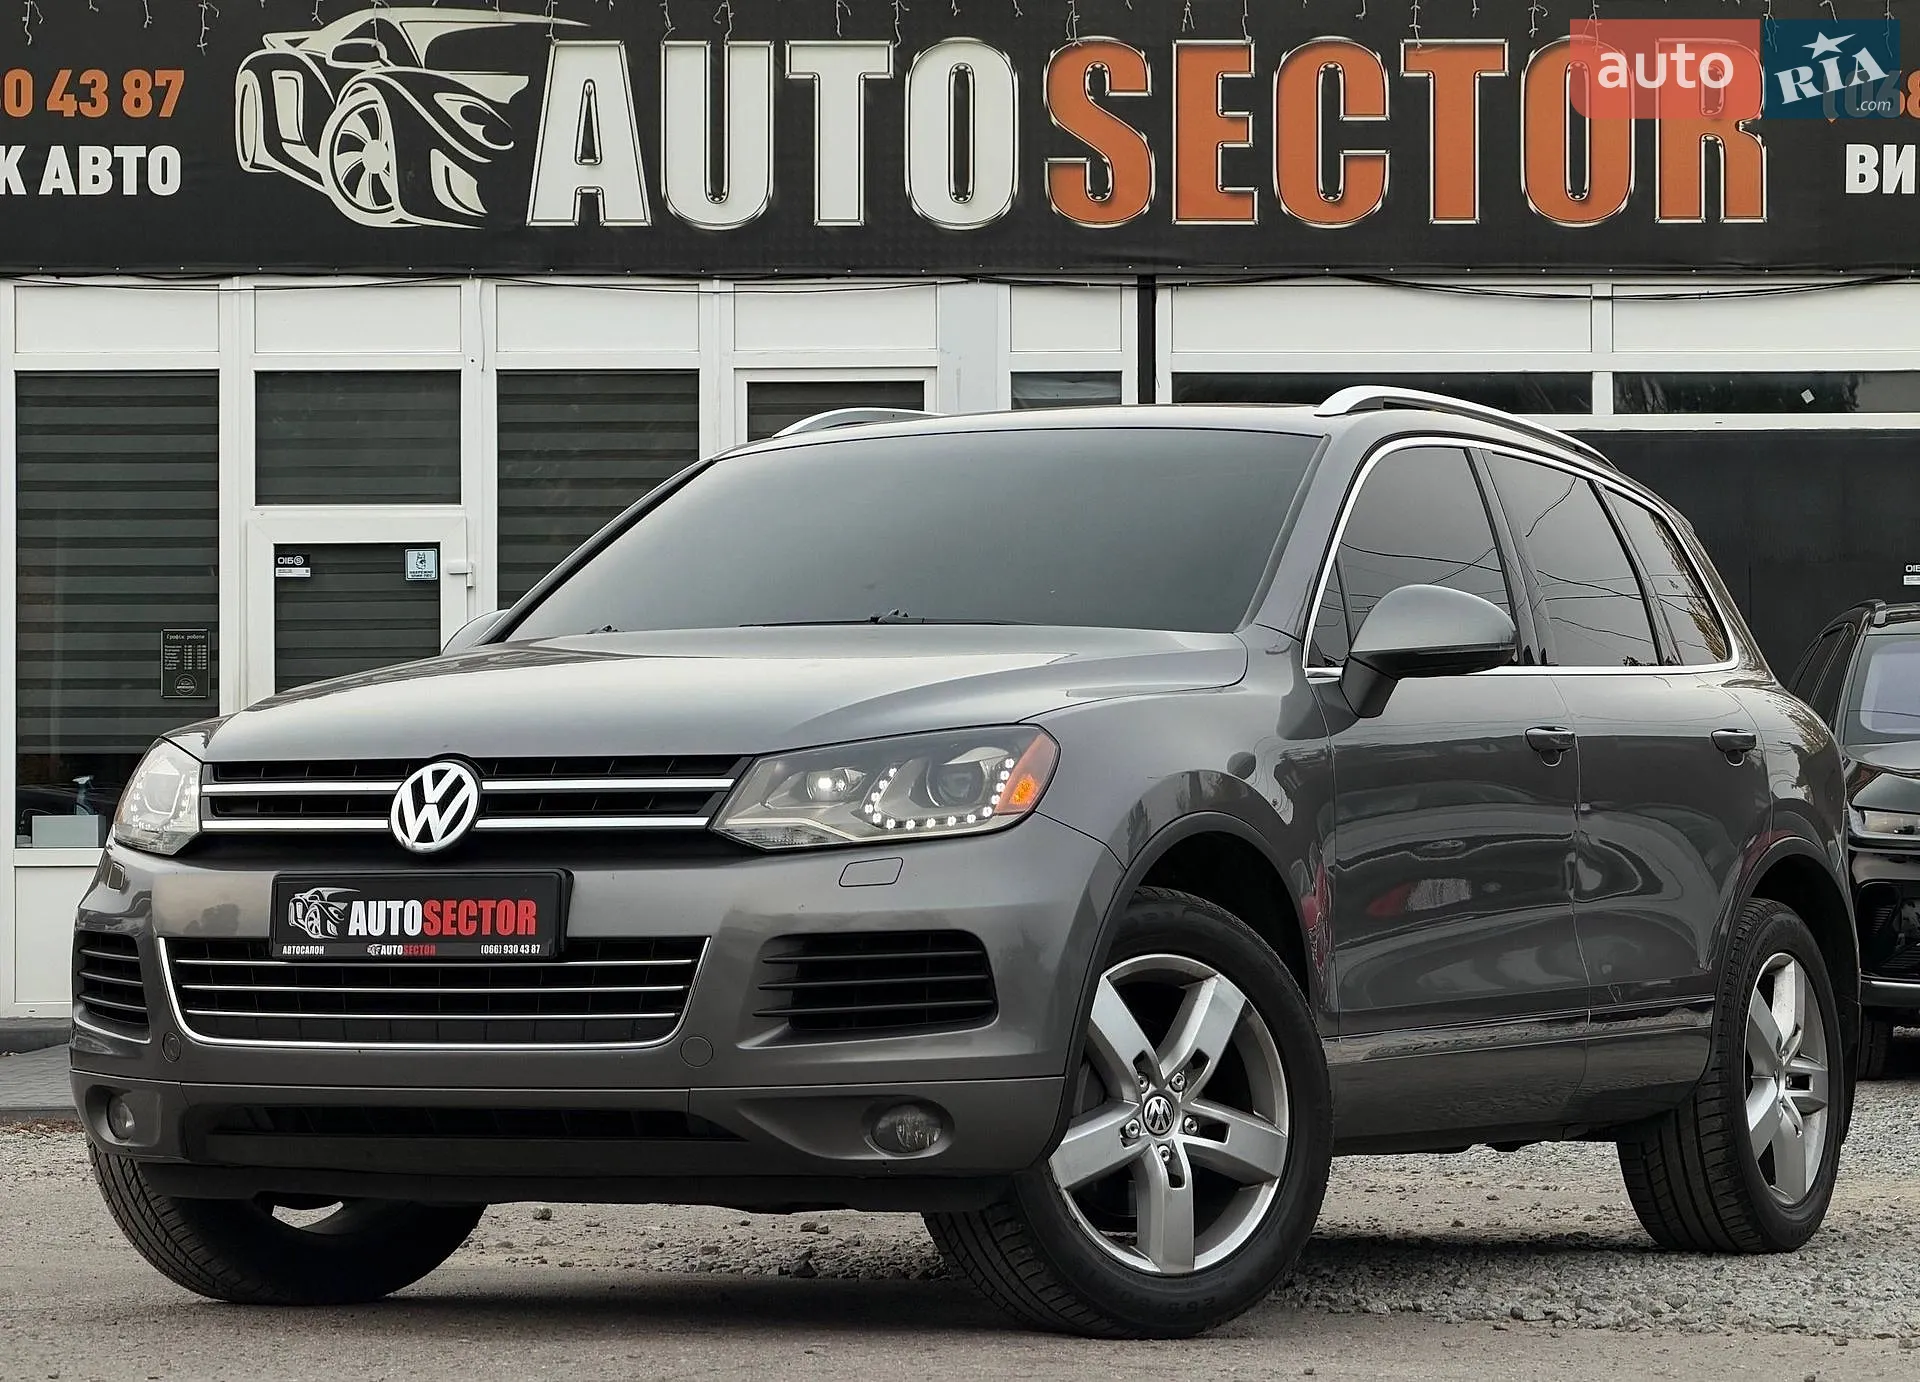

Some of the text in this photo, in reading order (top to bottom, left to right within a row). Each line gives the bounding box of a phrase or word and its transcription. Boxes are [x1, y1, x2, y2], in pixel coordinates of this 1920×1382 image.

[46, 68, 109, 119] 43
[122, 68, 186, 119] 87
[38, 145, 182, 196] АВТО
[347, 899, 537, 937] AUTOSECTOR
[282, 945, 324, 955] АВТОСАЛОН
[380, 944, 436, 956] AUTOSECTOR
[480, 944, 541, 955] (066) 930 43 87
